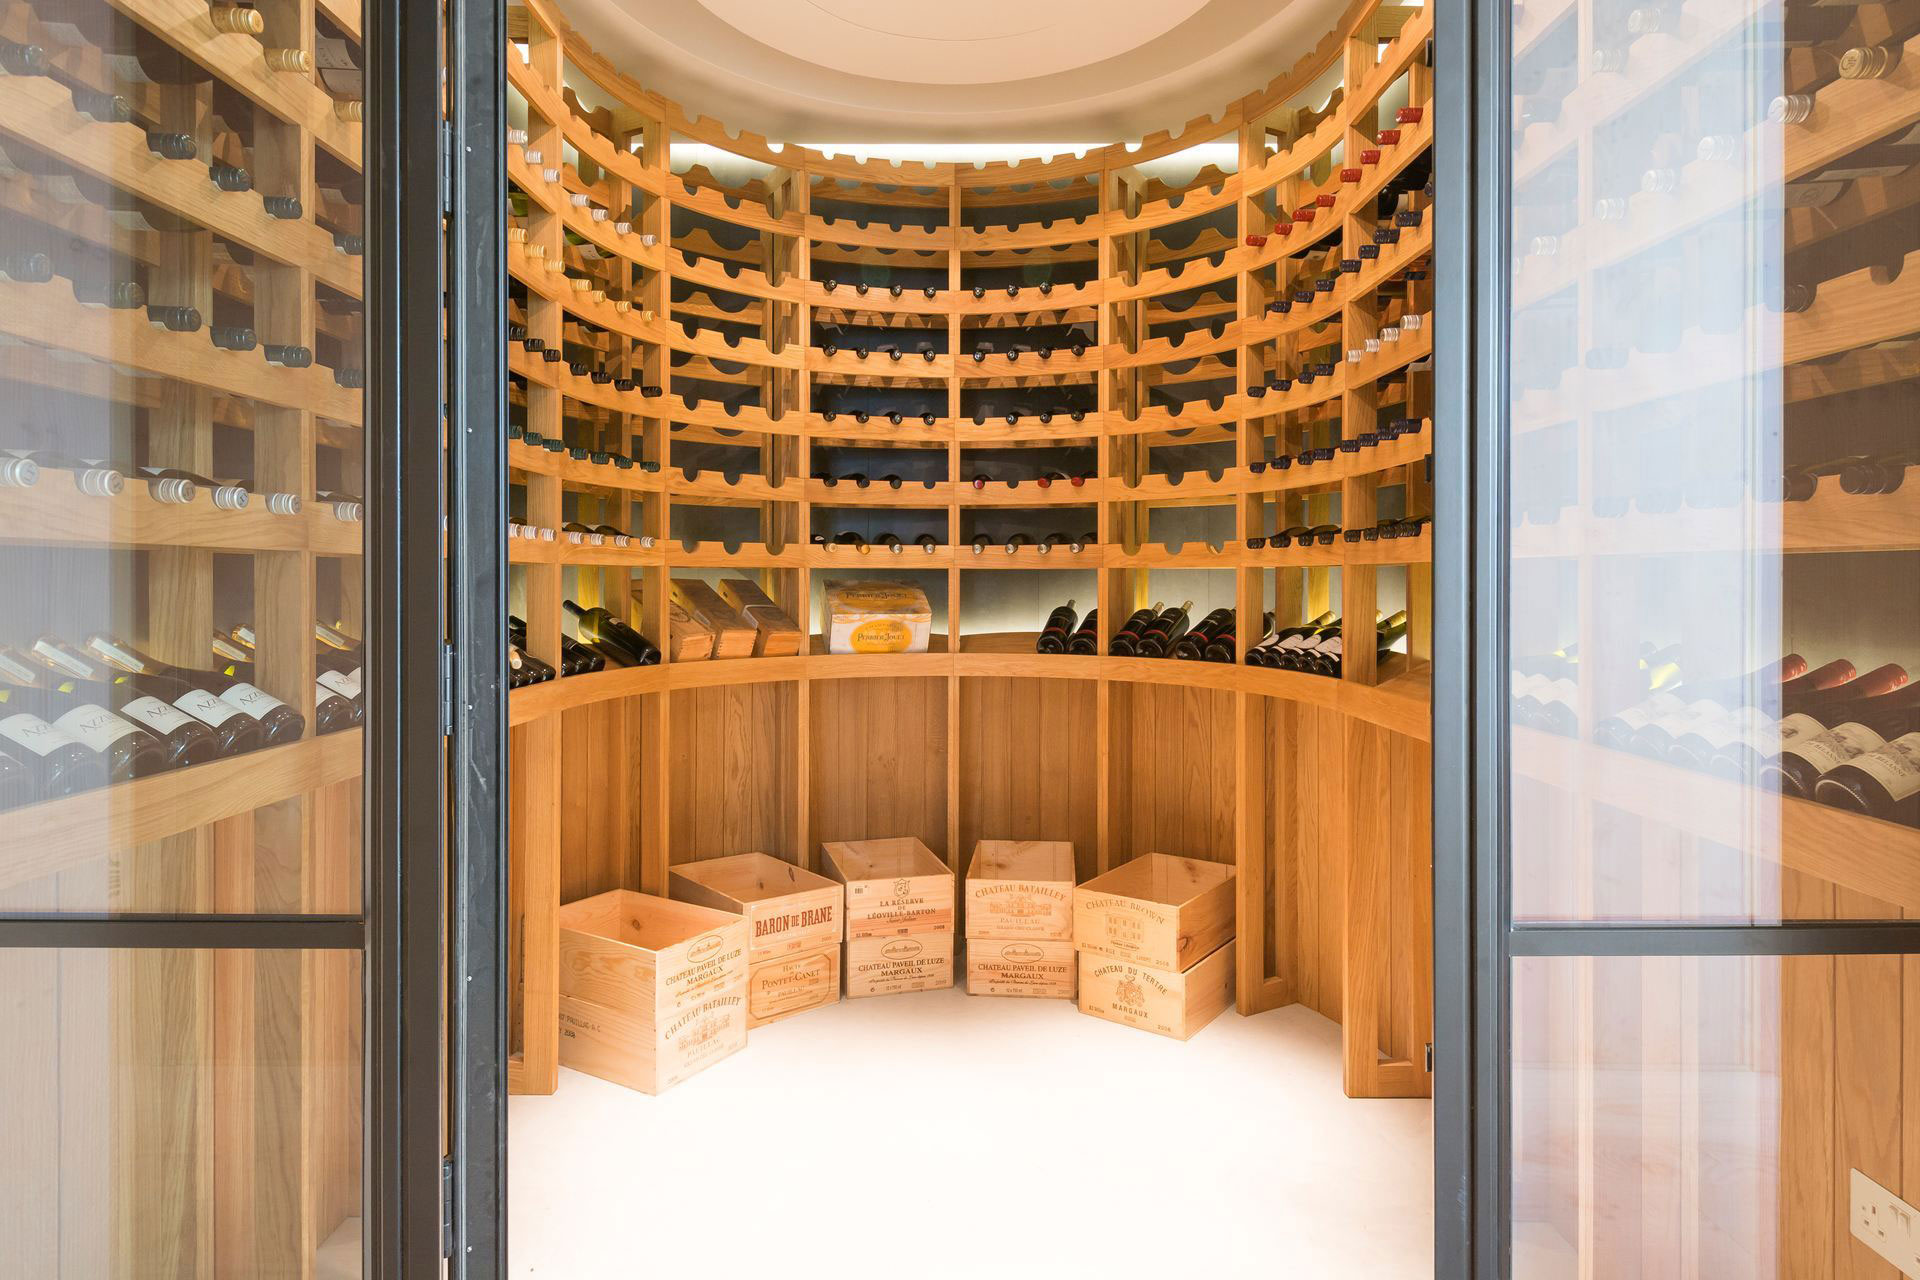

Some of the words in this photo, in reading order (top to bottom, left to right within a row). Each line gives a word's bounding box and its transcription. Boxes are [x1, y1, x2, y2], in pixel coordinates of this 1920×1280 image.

[975, 884, 1016, 898] CHATEAU
[1018, 884, 1066, 901] BATAILLEY
[1085, 899, 1126, 910] CHATEAU
[1130, 902, 1165, 925] BROWN
[755, 914, 790, 938] BARON
[791, 914, 800, 927] DE
[801, 905, 833, 928] BRANE
[665, 967, 697, 987] CHATEAU
[717, 954, 727, 964] DE
[858, 961, 890, 972] CHATEAU
[892, 960, 915, 969] PAVEIL
[927, 957, 945, 965] LUZE
[881, 967, 923, 977] MARGAUX
[978, 963, 1011, 972] CHATEAU
[1012, 964, 1036, 972] PAVEIL
[686, 965, 724, 985] MARGAUX
[1001, 972, 1044, 980] MARGAUX
[1094, 965, 1123, 978] CHATEAU
[1127, 966, 1138, 976] DU
[1142, 972, 1168, 996] TERTRE
[1112, 1002, 1149, 1019] MARGAUX
[664, 1006, 701, 1040] CHATEAU
